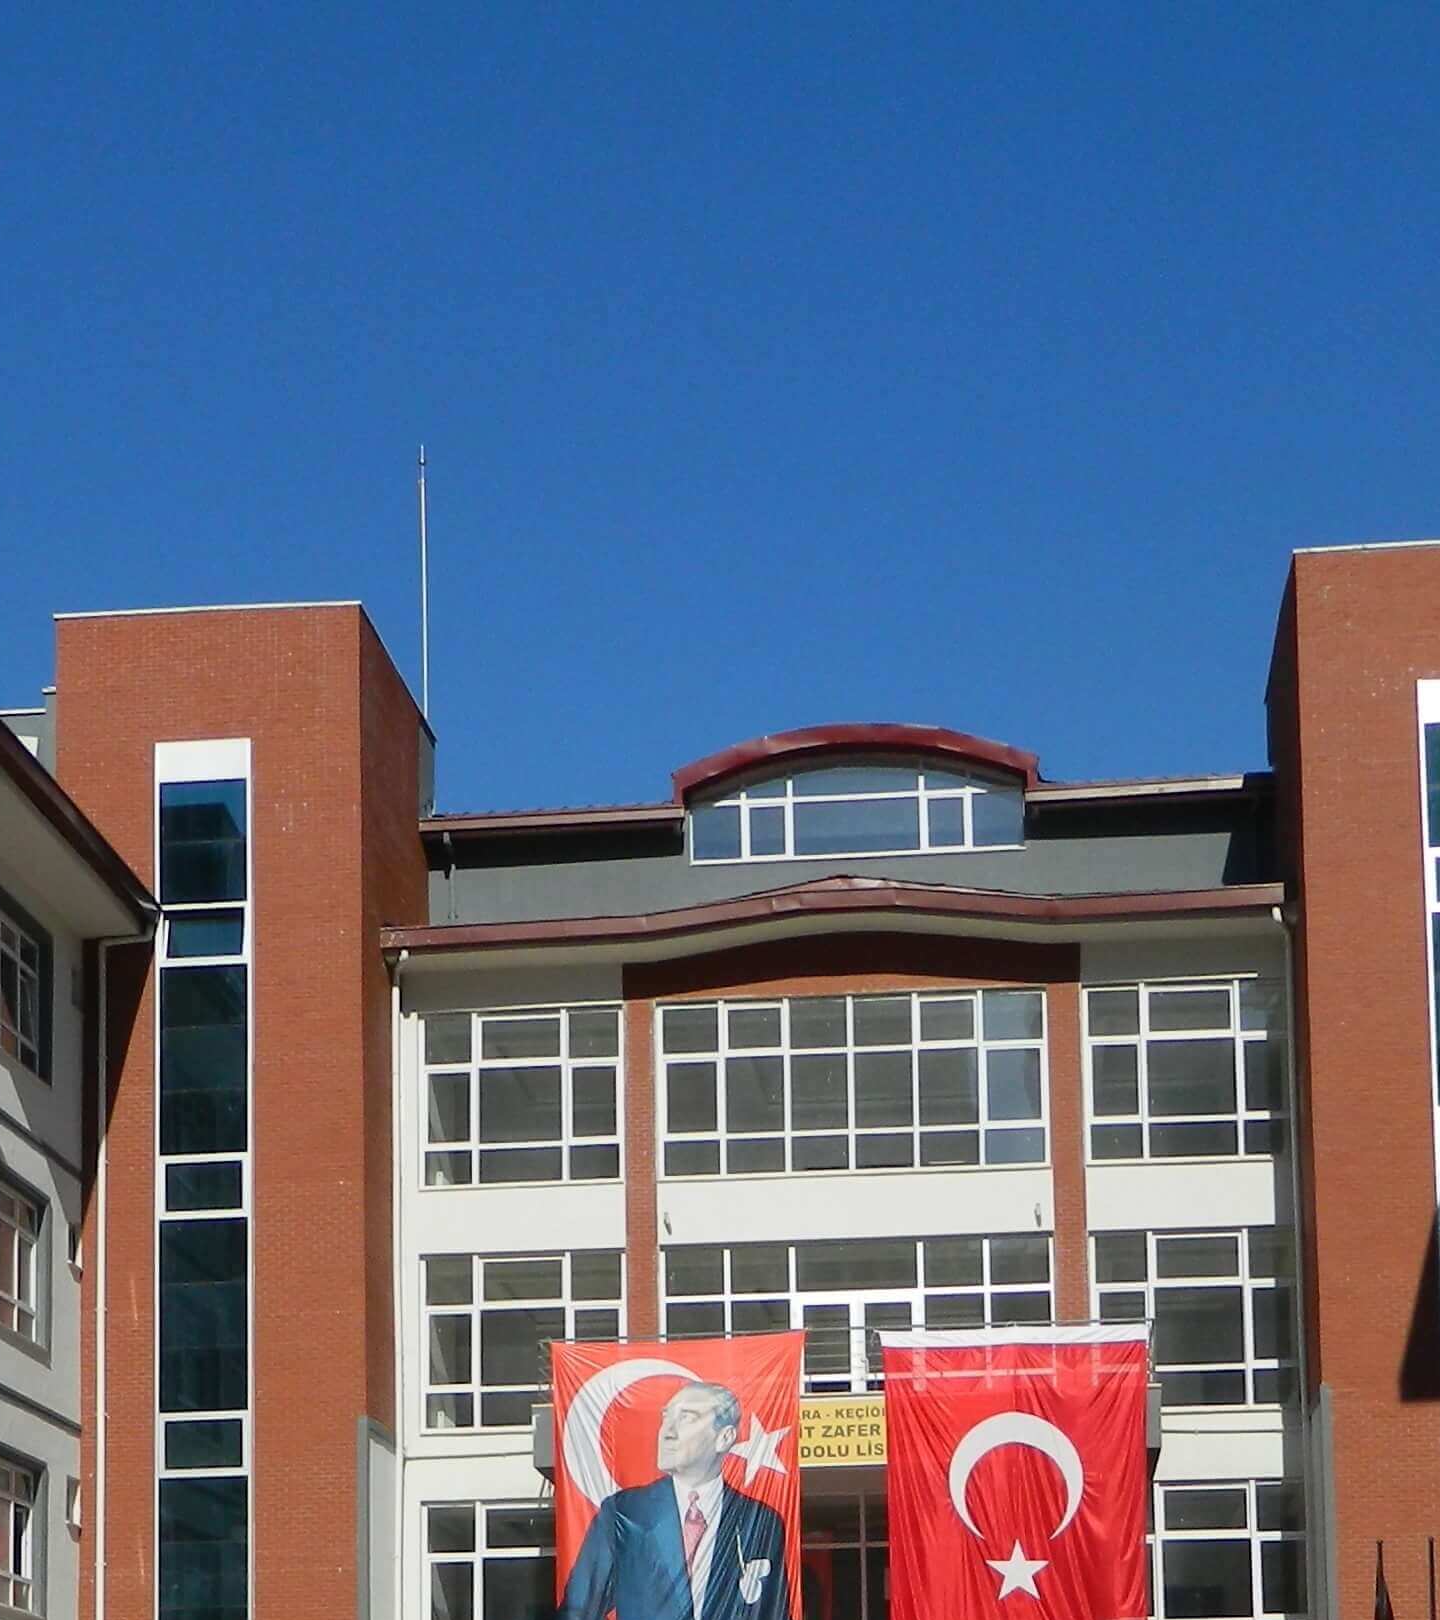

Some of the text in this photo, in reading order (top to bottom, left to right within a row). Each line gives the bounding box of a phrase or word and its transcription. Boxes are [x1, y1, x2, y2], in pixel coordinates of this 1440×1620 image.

[800, 1409, 821, 1420] RA
[835, 1405, 885, 1420] KEÇİÖ
[821, 1423, 881, 1438] ZAFER
[800, 1444, 849, 1458] DOLU
